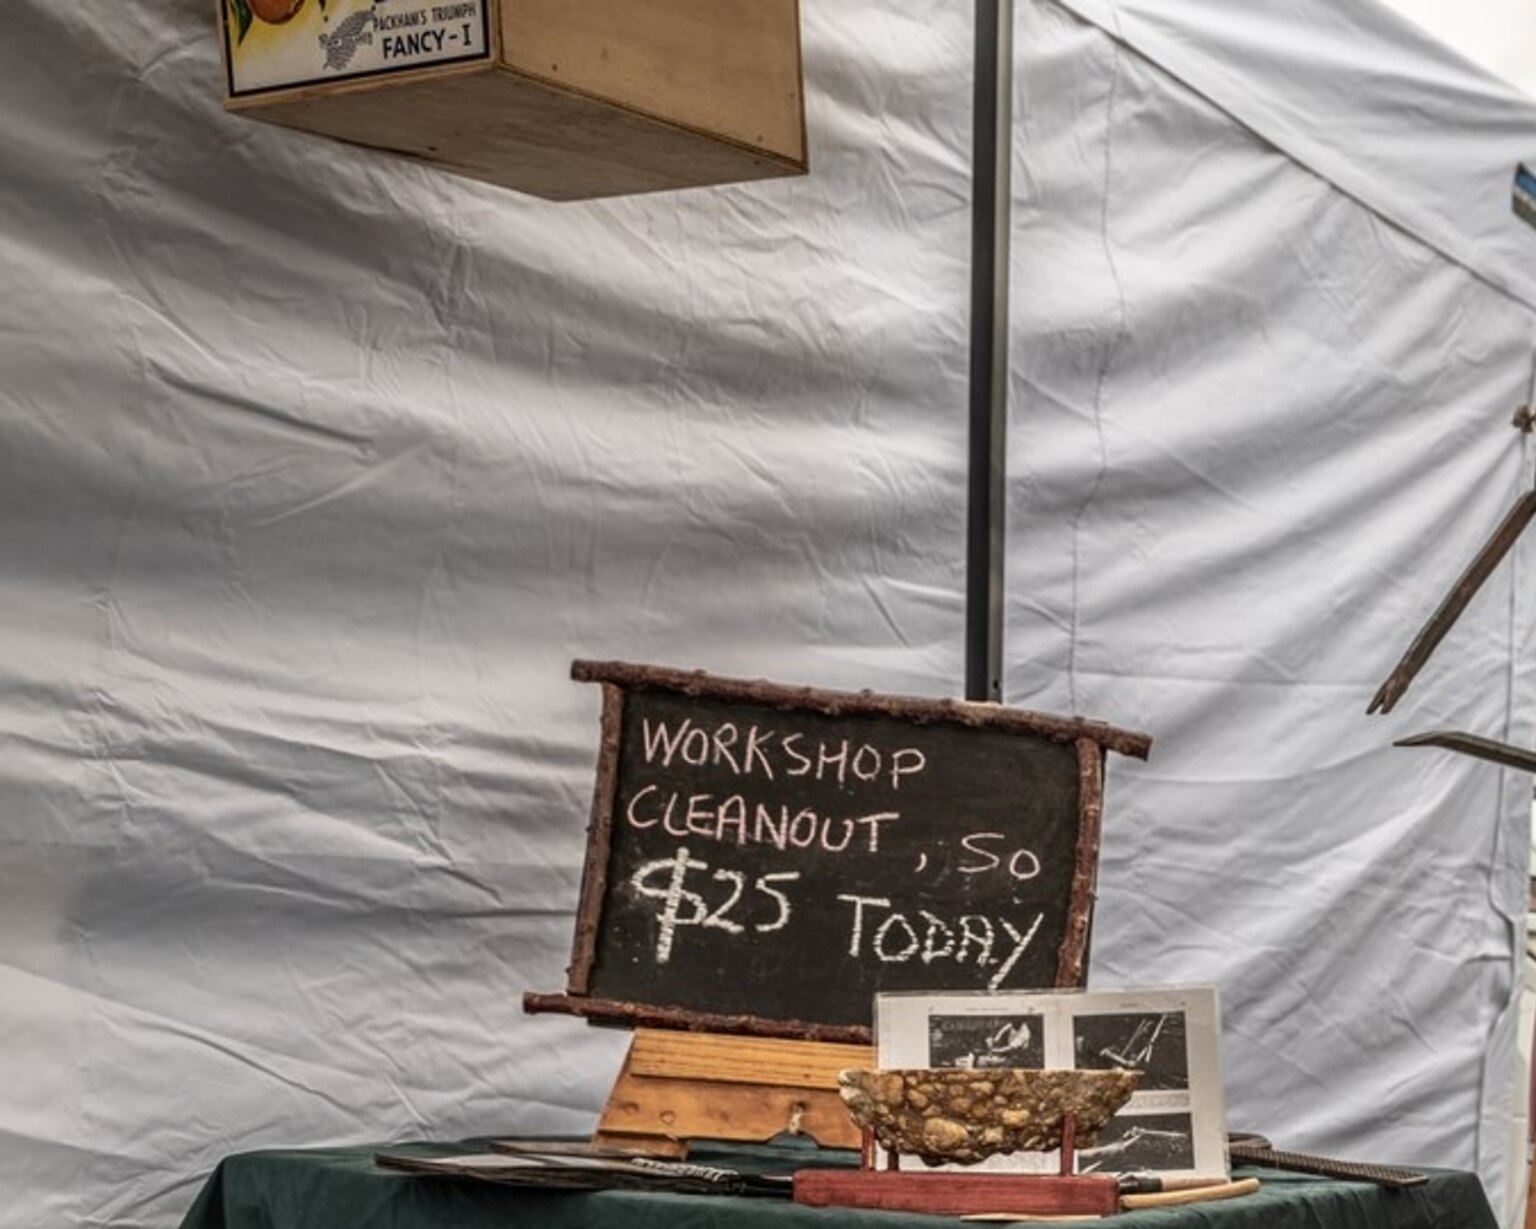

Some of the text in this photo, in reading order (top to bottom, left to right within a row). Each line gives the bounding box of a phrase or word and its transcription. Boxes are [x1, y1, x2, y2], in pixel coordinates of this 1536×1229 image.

[642, 718, 926, 789] WORKSHOP
[628, 846, 1044, 991] $25 TODAY
